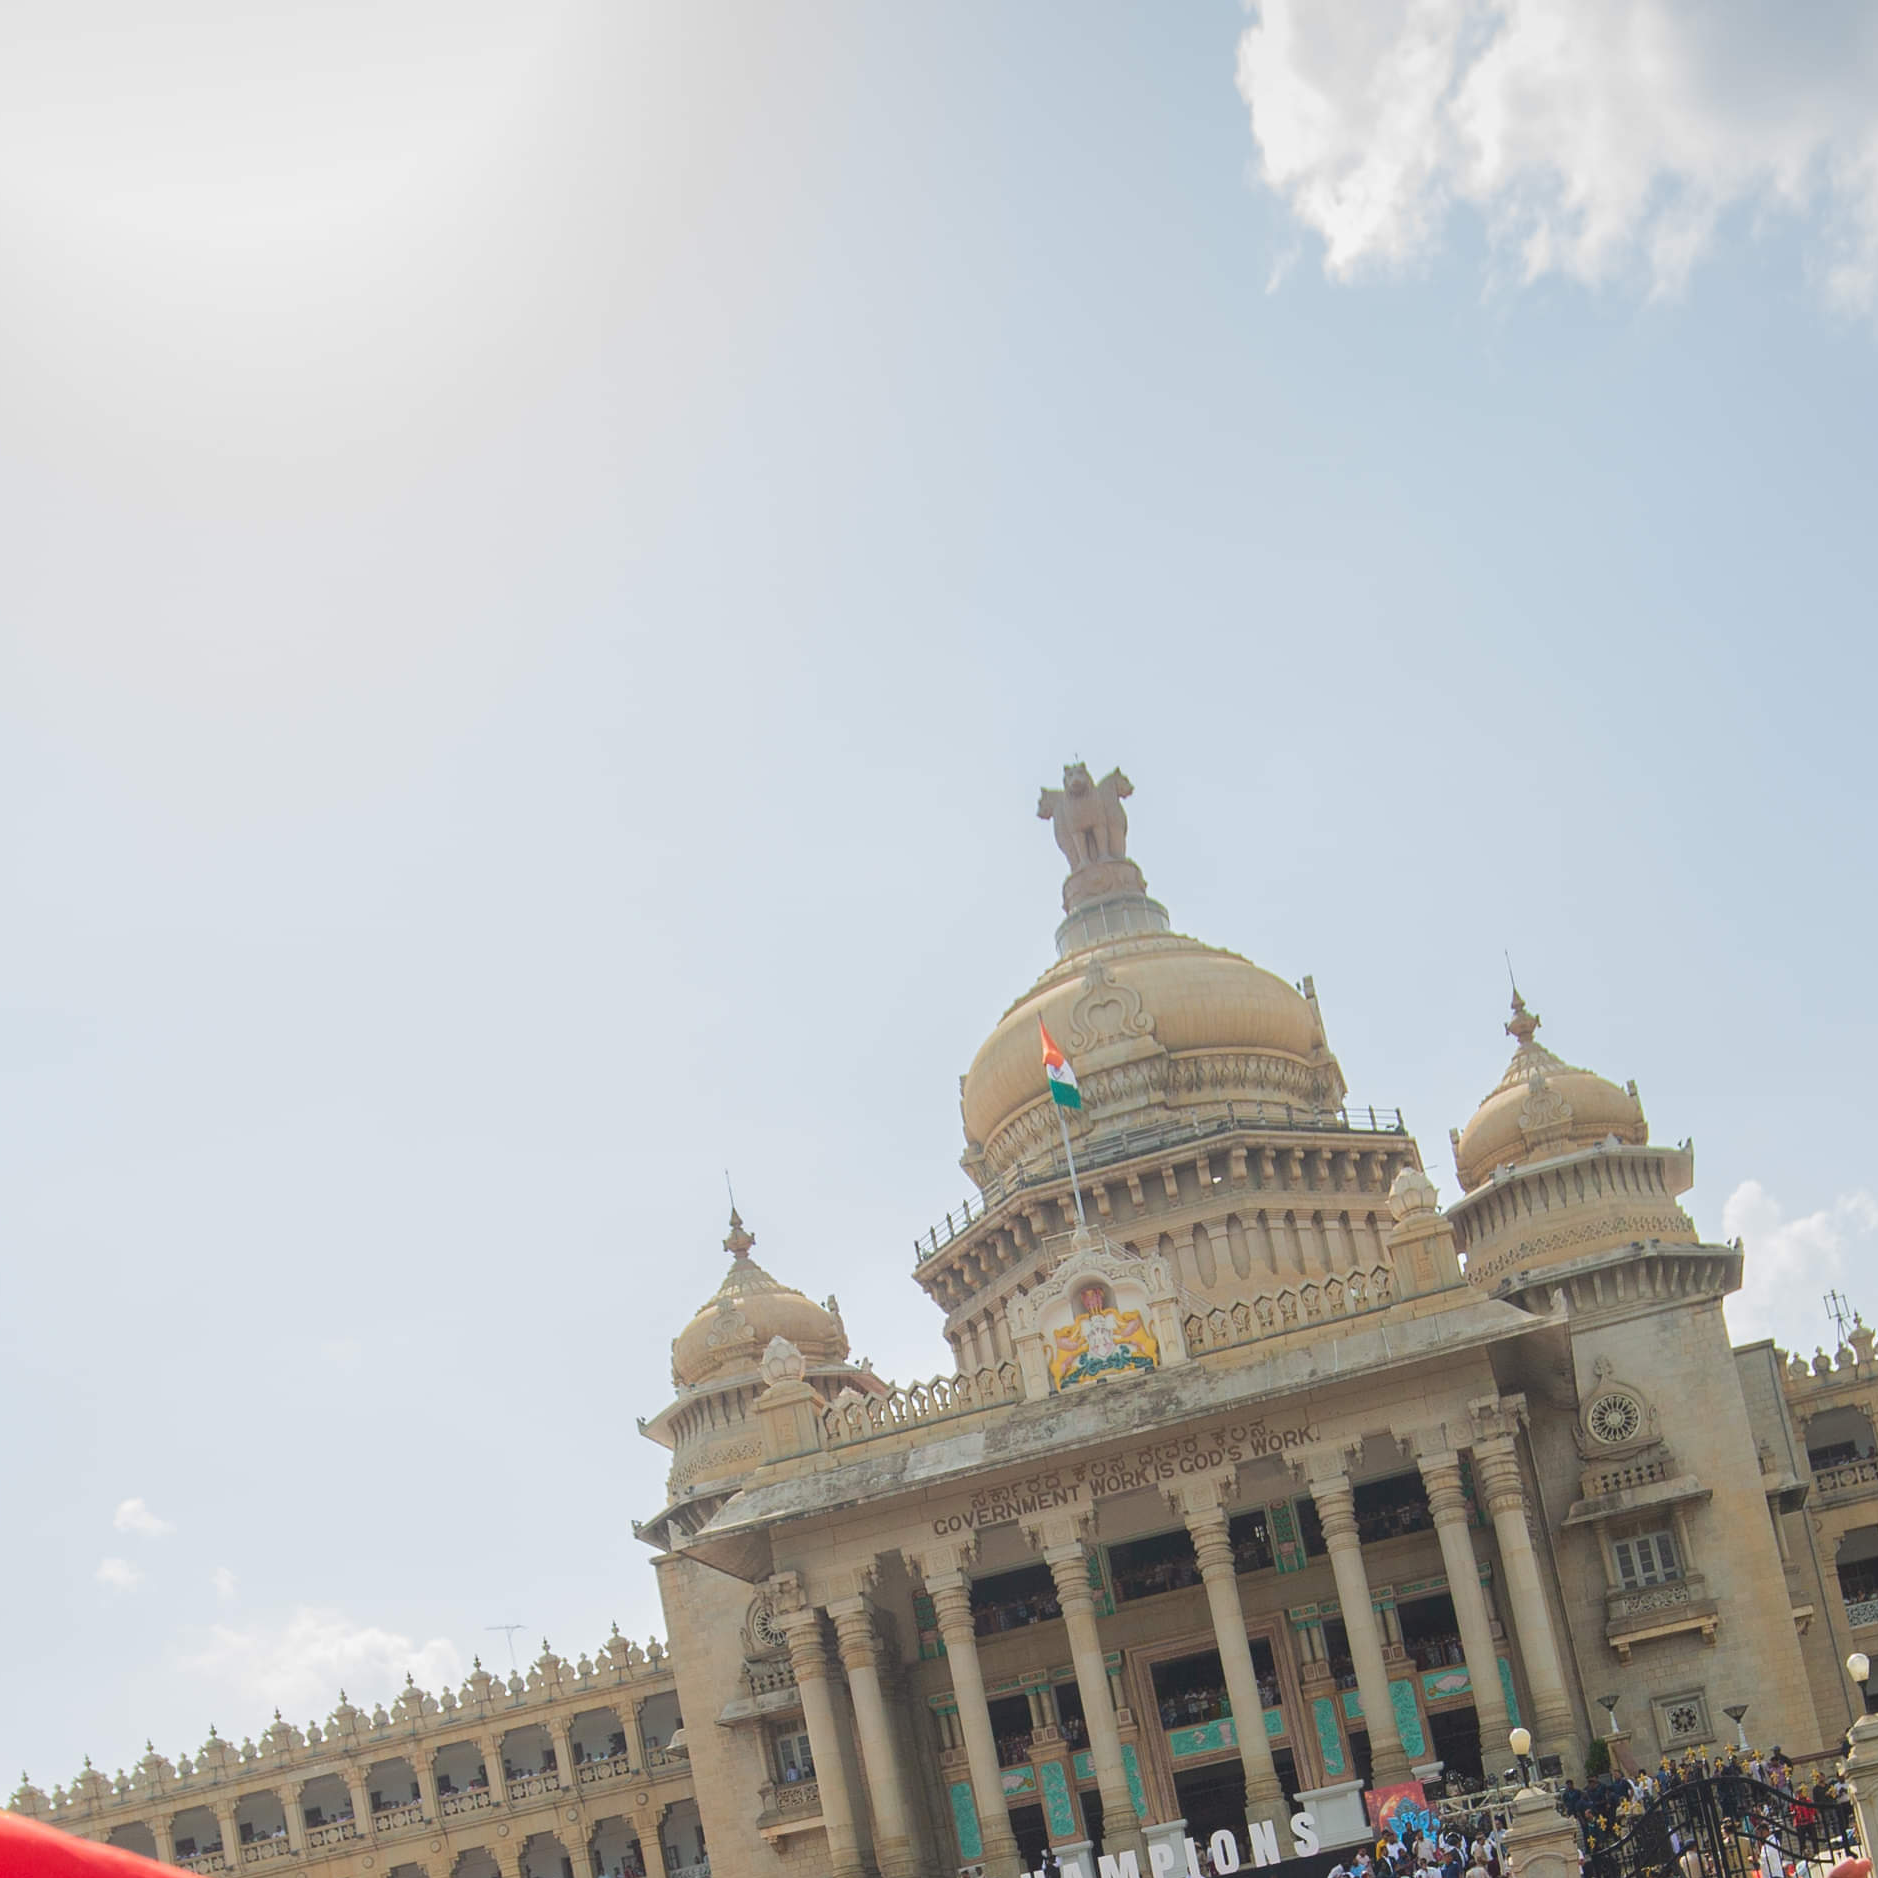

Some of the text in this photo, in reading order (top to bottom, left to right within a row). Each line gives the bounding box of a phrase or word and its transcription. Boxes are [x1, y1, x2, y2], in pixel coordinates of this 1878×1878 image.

[933, 1425, 1320, 1535] GOVERNMENT WORK IS GOD'S WORK.
